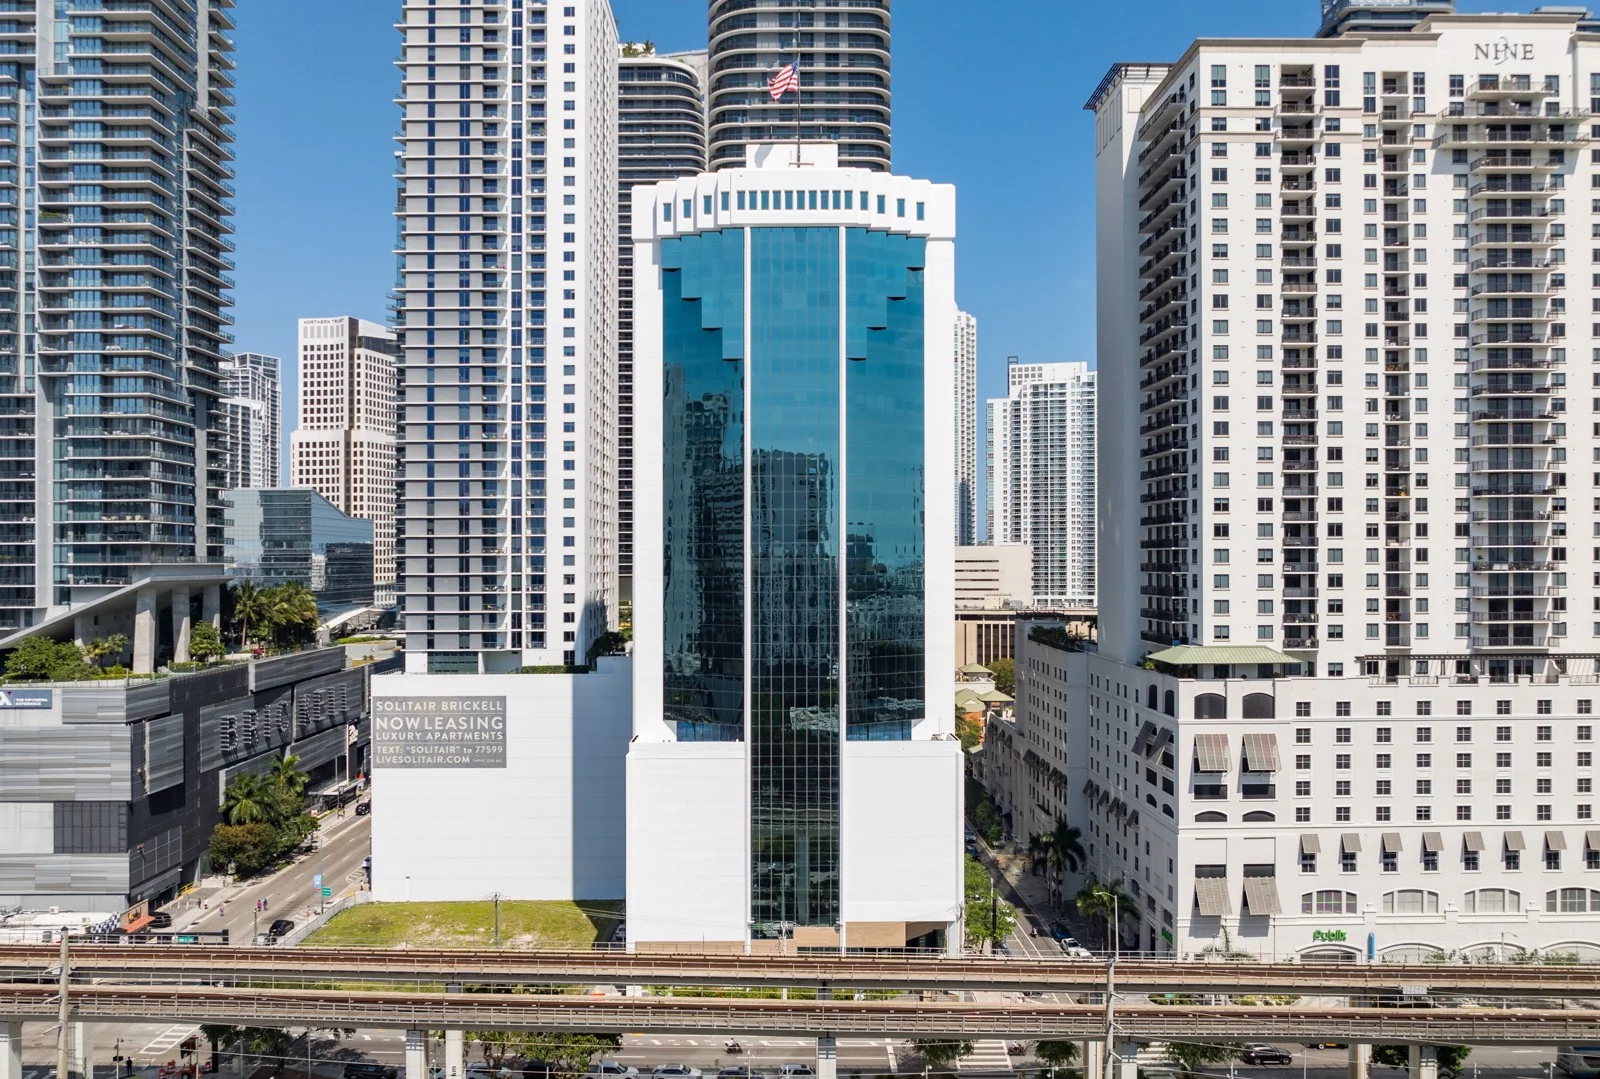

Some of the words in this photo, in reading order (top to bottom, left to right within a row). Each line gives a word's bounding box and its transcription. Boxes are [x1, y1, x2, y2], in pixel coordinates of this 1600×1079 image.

[1474, 42, 1534, 61] NINE
[376, 701, 436, 711] SOLITAIR
[441, 701, 503, 711] BRICKELL
[220, 684, 350, 751] BRICKELL
[376, 716, 420, 730] NOW
[424, 716, 503, 730] LEASING
[376, 732, 422, 740] LUXURY
[425, 732, 503, 740] APARTMENTS
[376, 746, 403, 754] TEXT:
[463, 746, 473, 754] to
[475, 746, 503, 754] 77599
[376, 756, 470, 764] LIVESOLITAIR.COM
[1312, 929, 1347, 942] Publix
